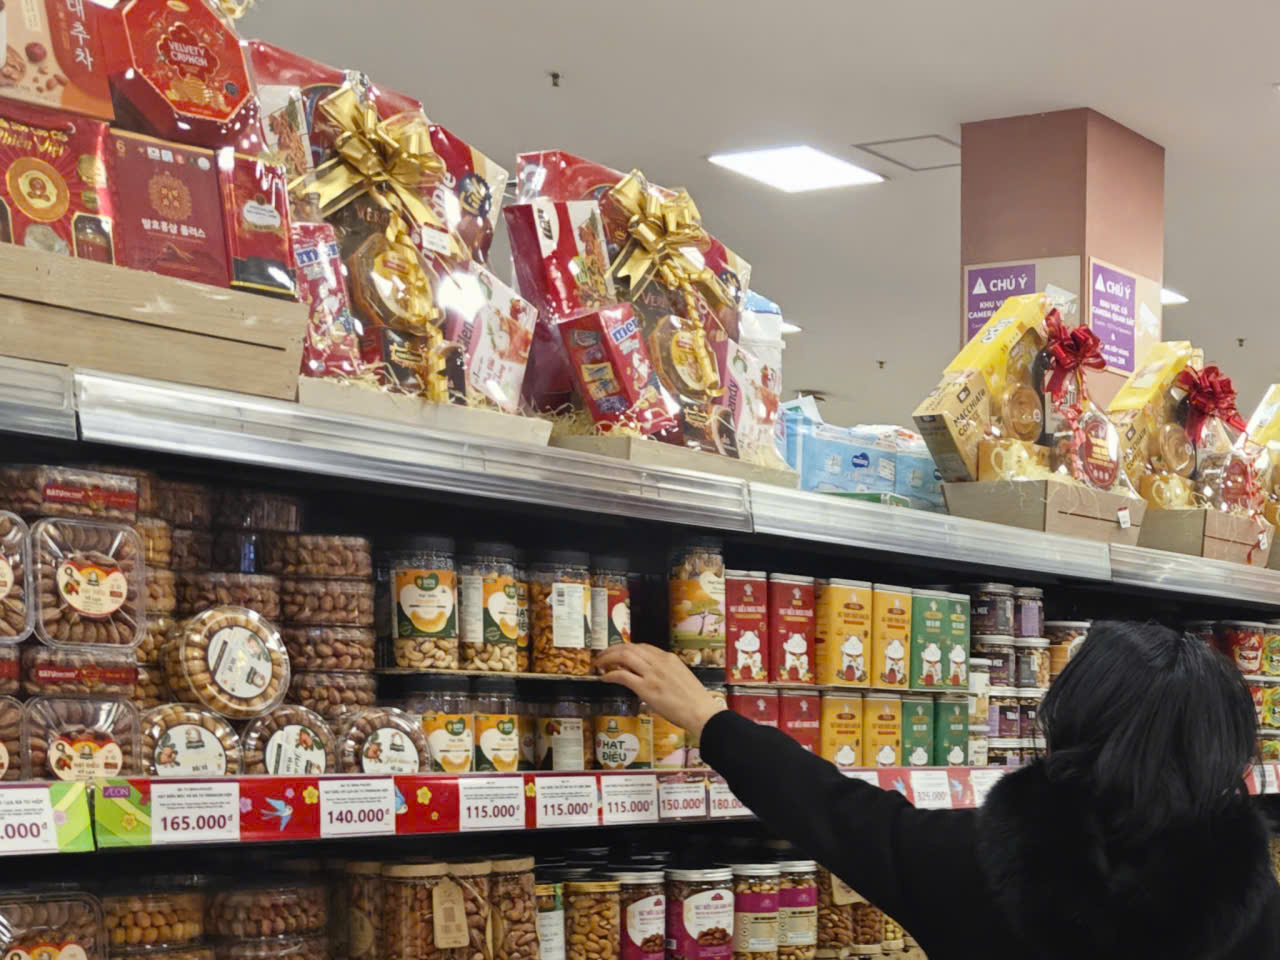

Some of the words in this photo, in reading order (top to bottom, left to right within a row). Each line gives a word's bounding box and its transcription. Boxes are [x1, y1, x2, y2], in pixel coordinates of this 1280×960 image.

[167, 40, 206, 56] VELVETY
[989, 275, 1015, 292] CHÚ
[1018, 273, 1028, 290] Ý
[1106, 279, 1124, 296] CHÚ
[712, 798, 744, 811] 180.00
